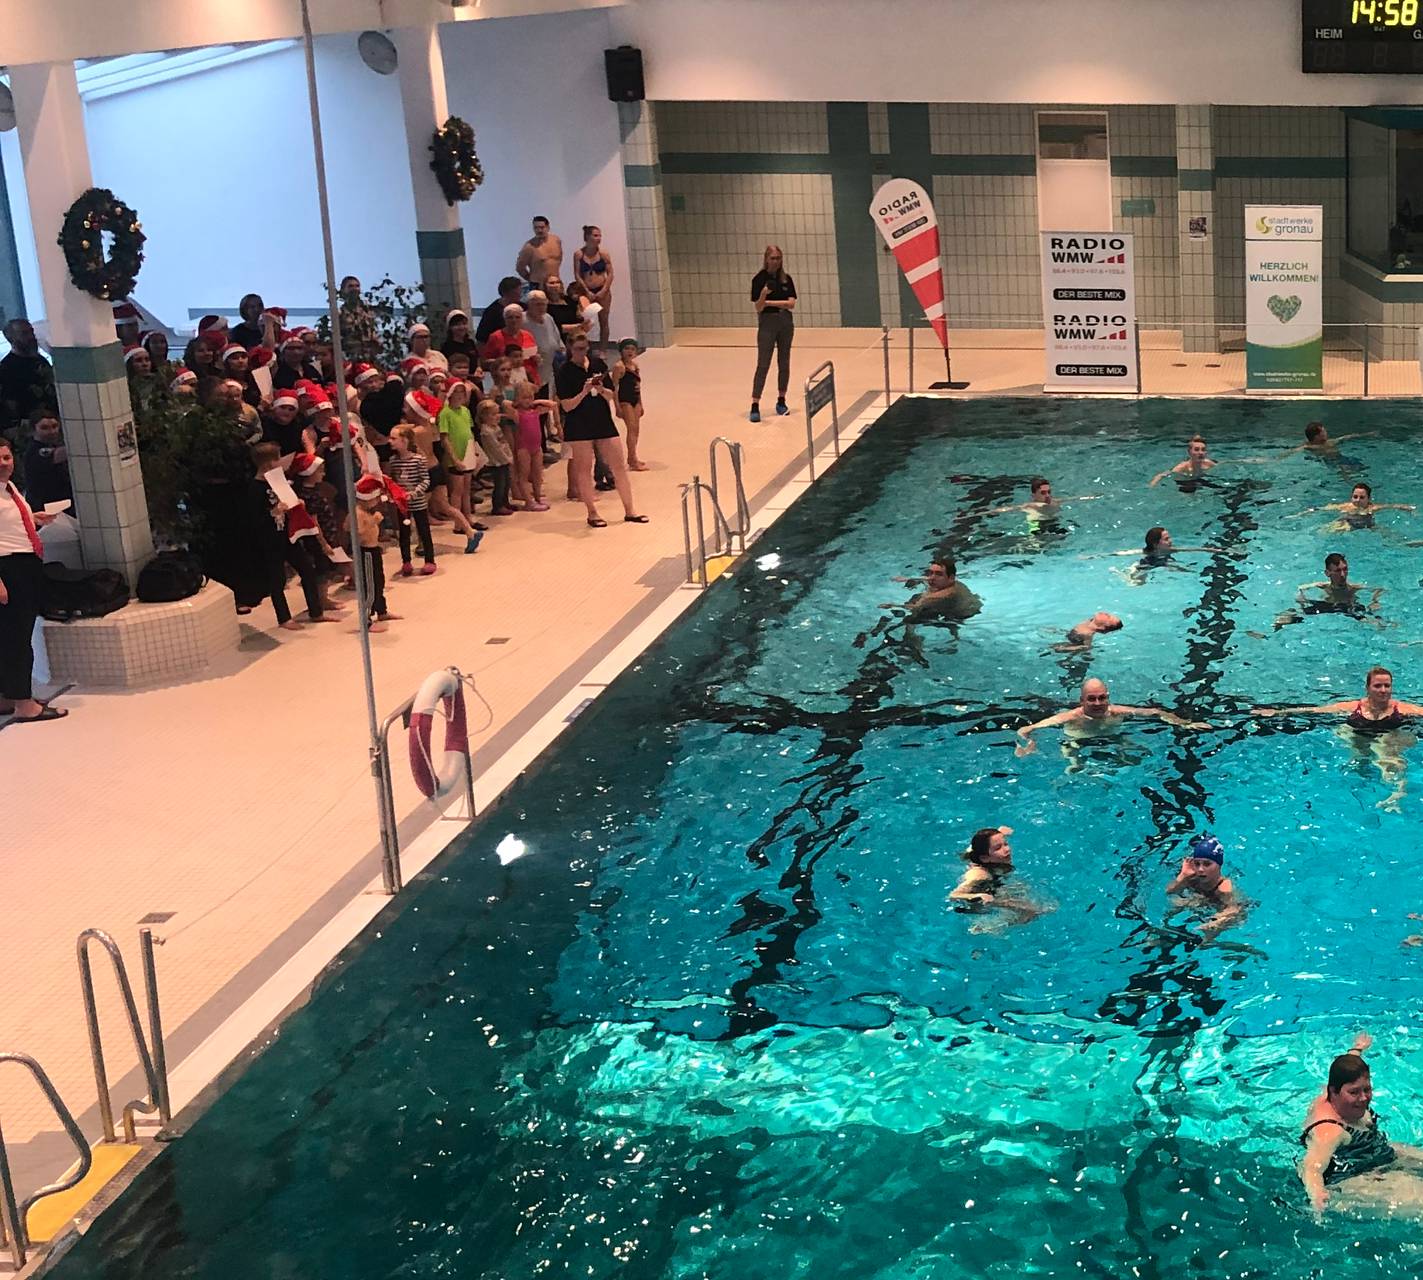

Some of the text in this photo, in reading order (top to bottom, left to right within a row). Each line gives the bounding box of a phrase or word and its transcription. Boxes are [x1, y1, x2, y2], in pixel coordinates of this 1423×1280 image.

[1351, 0, 1419, 26] 14:58
[1315, 28, 1343, 39] HEIM
[1274, 224, 1314, 236] gronau
[1050, 238, 1125, 250] RADIO
[1051, 252, 1094, 264] WMW
[1260, 261, 1308, 271] HERZLICH
[1249, 274, 1319, 283] WILLKOMMEN!
[1057, 290, 1076, 298] DER
[1077, 290, 1103, 299] BESTE
[1053, 314, 1127, 327] RADIO
[1054, 328, 1096, 340] WMW
[1060, 366, 1078, 374] DER
[1079, 366, 1105, 374] BESTE
